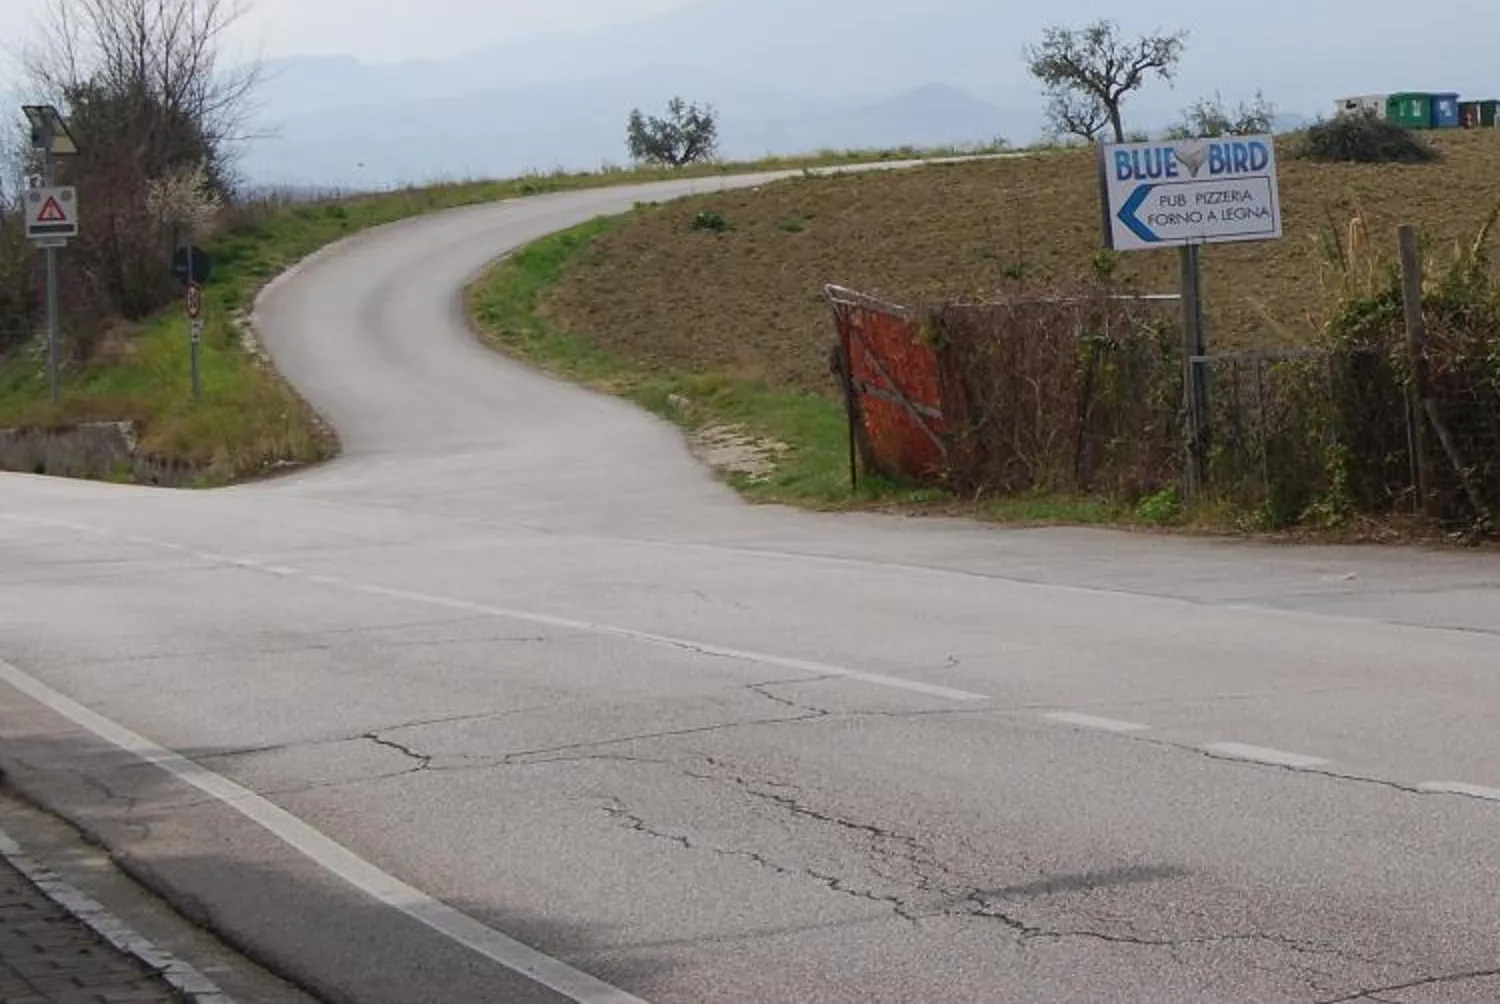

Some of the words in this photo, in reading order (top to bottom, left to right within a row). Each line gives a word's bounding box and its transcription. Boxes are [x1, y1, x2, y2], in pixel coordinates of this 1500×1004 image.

[1115, 148, 1178, 180] BLUE
[1208, 141, 1269, 174] BIRD
[1159, 194, 1186, 207] PUB
[1196, 189, 1253, 205] PIZZERIA
[1147, 211, 1203, 227] FORNO
[1207, 210, 1218, 222] A
[1221, 206, 1269, 221] LEGNA
